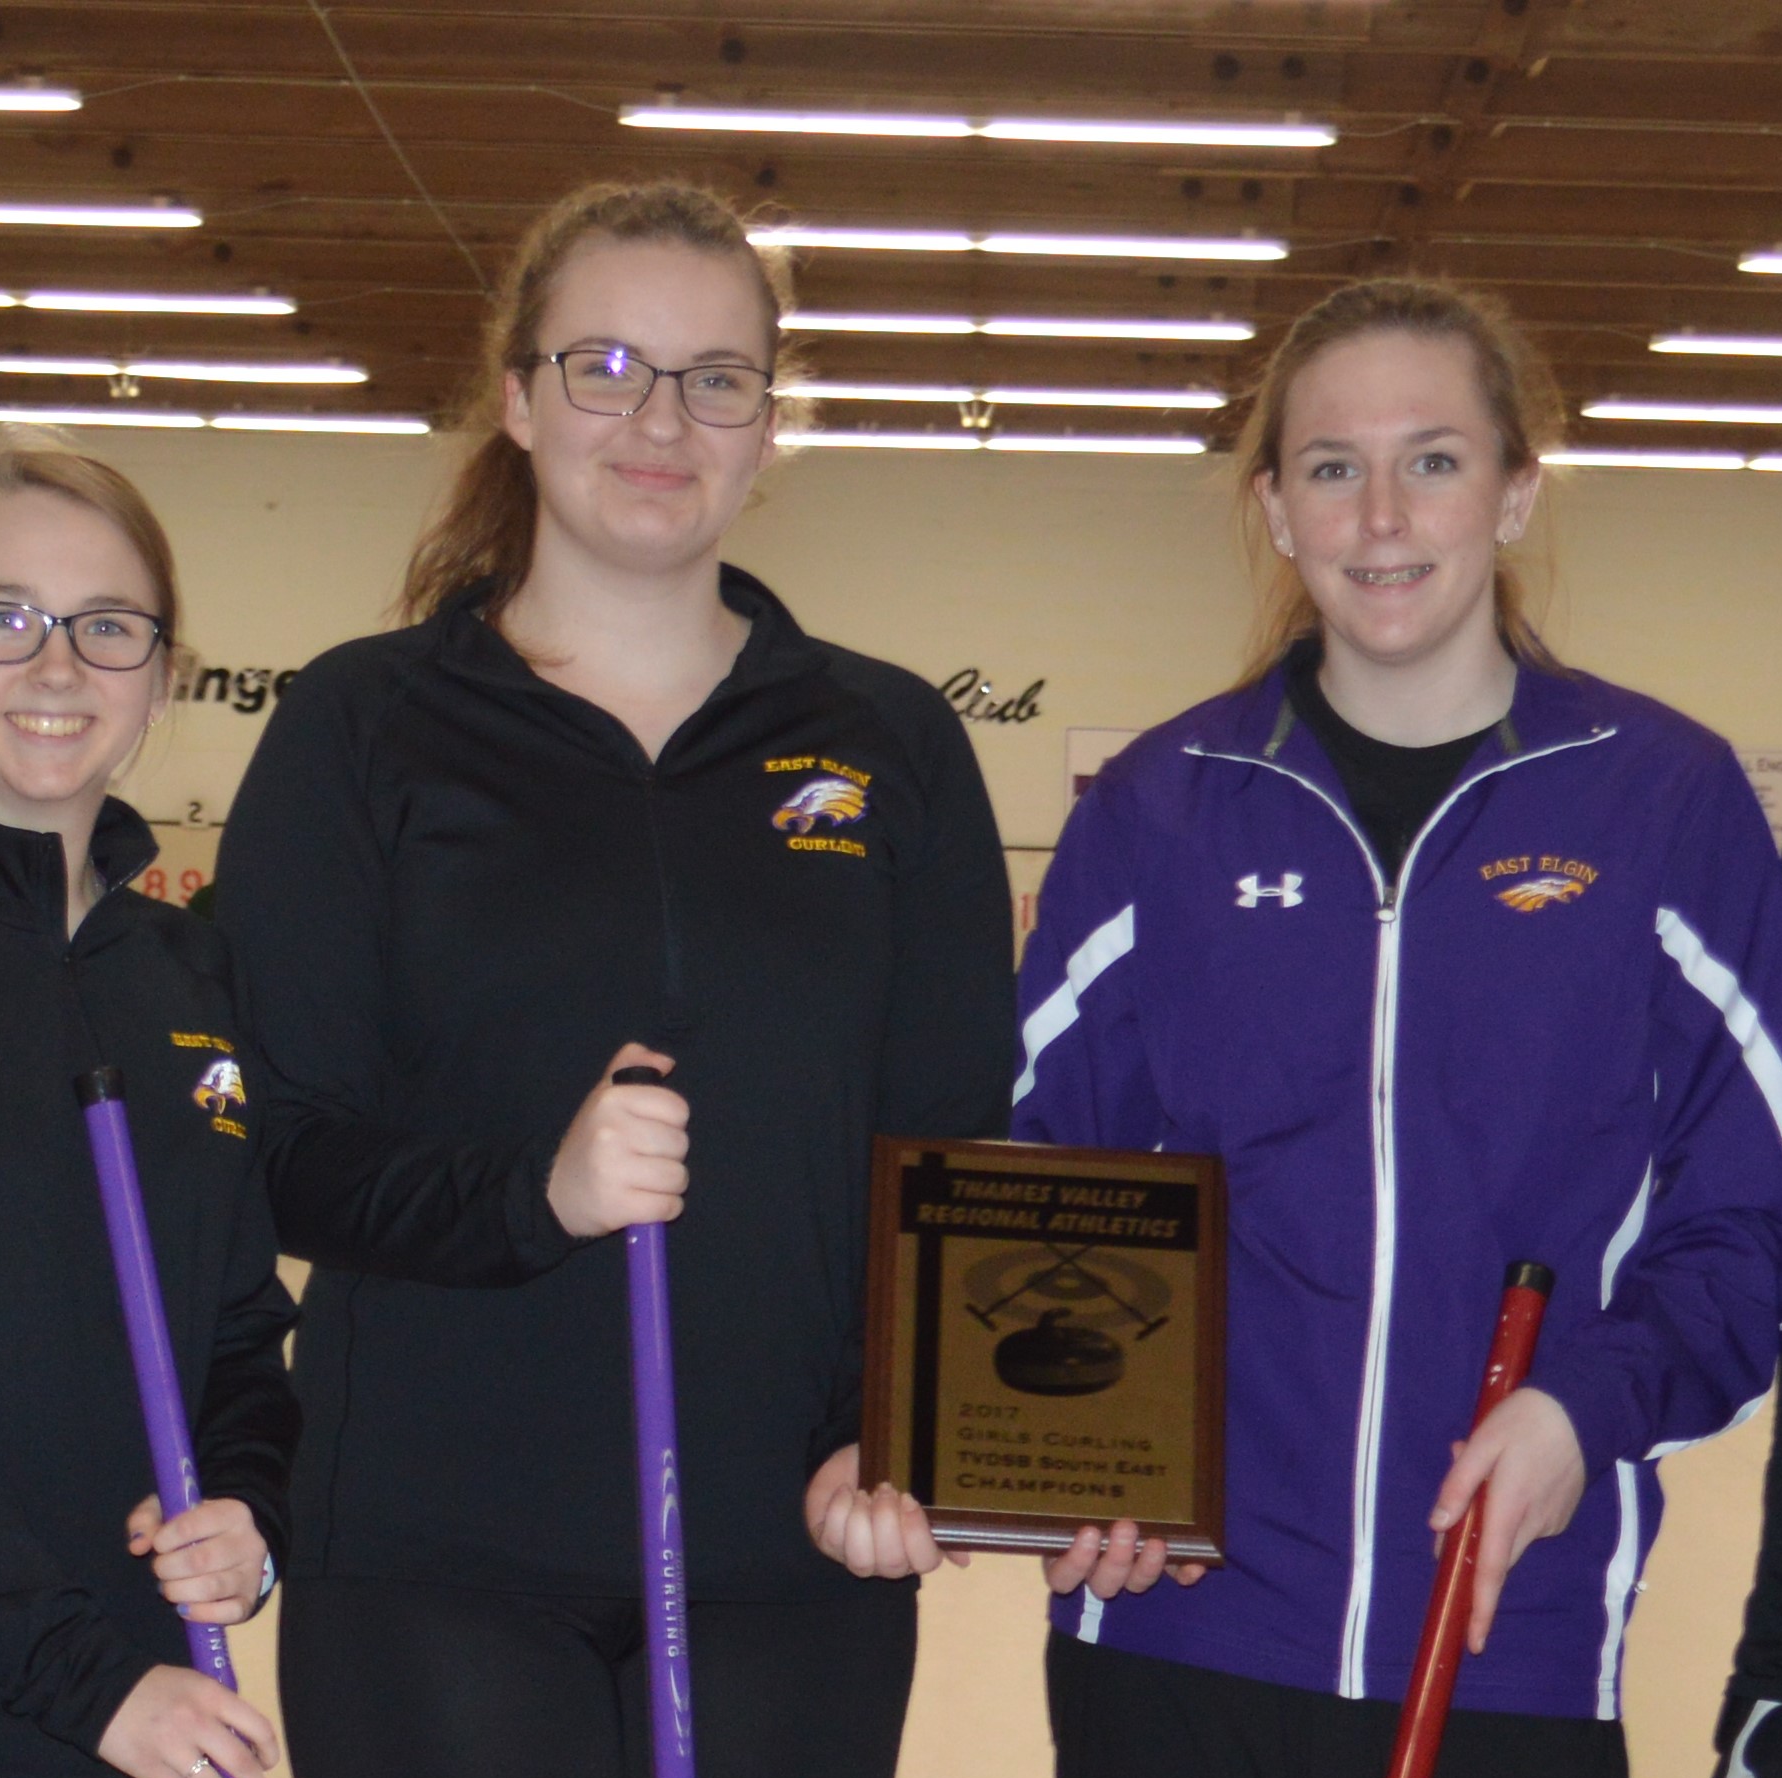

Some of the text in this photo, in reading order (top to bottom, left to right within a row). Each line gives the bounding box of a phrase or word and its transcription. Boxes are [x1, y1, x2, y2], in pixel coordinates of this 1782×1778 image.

[939, 667, 1046, 725] Club
[764, 756, 816, 773] EAST
[187, 801, 202, 823] 2
[1480, 856, 1599, 885] EAST ELGIN
[143, 868, 204, 904] 8 9
[949, 1179, 1151, 1210] THAMES VALLEY
[917, 1203, 1180, 1240] REGIONAL ATHLETICS
[957, 1402, 1021, 1421] 2017
[956, 1450, 1033, 1469] TVDSB
[662, 1548, 680, 1658] CURLING
